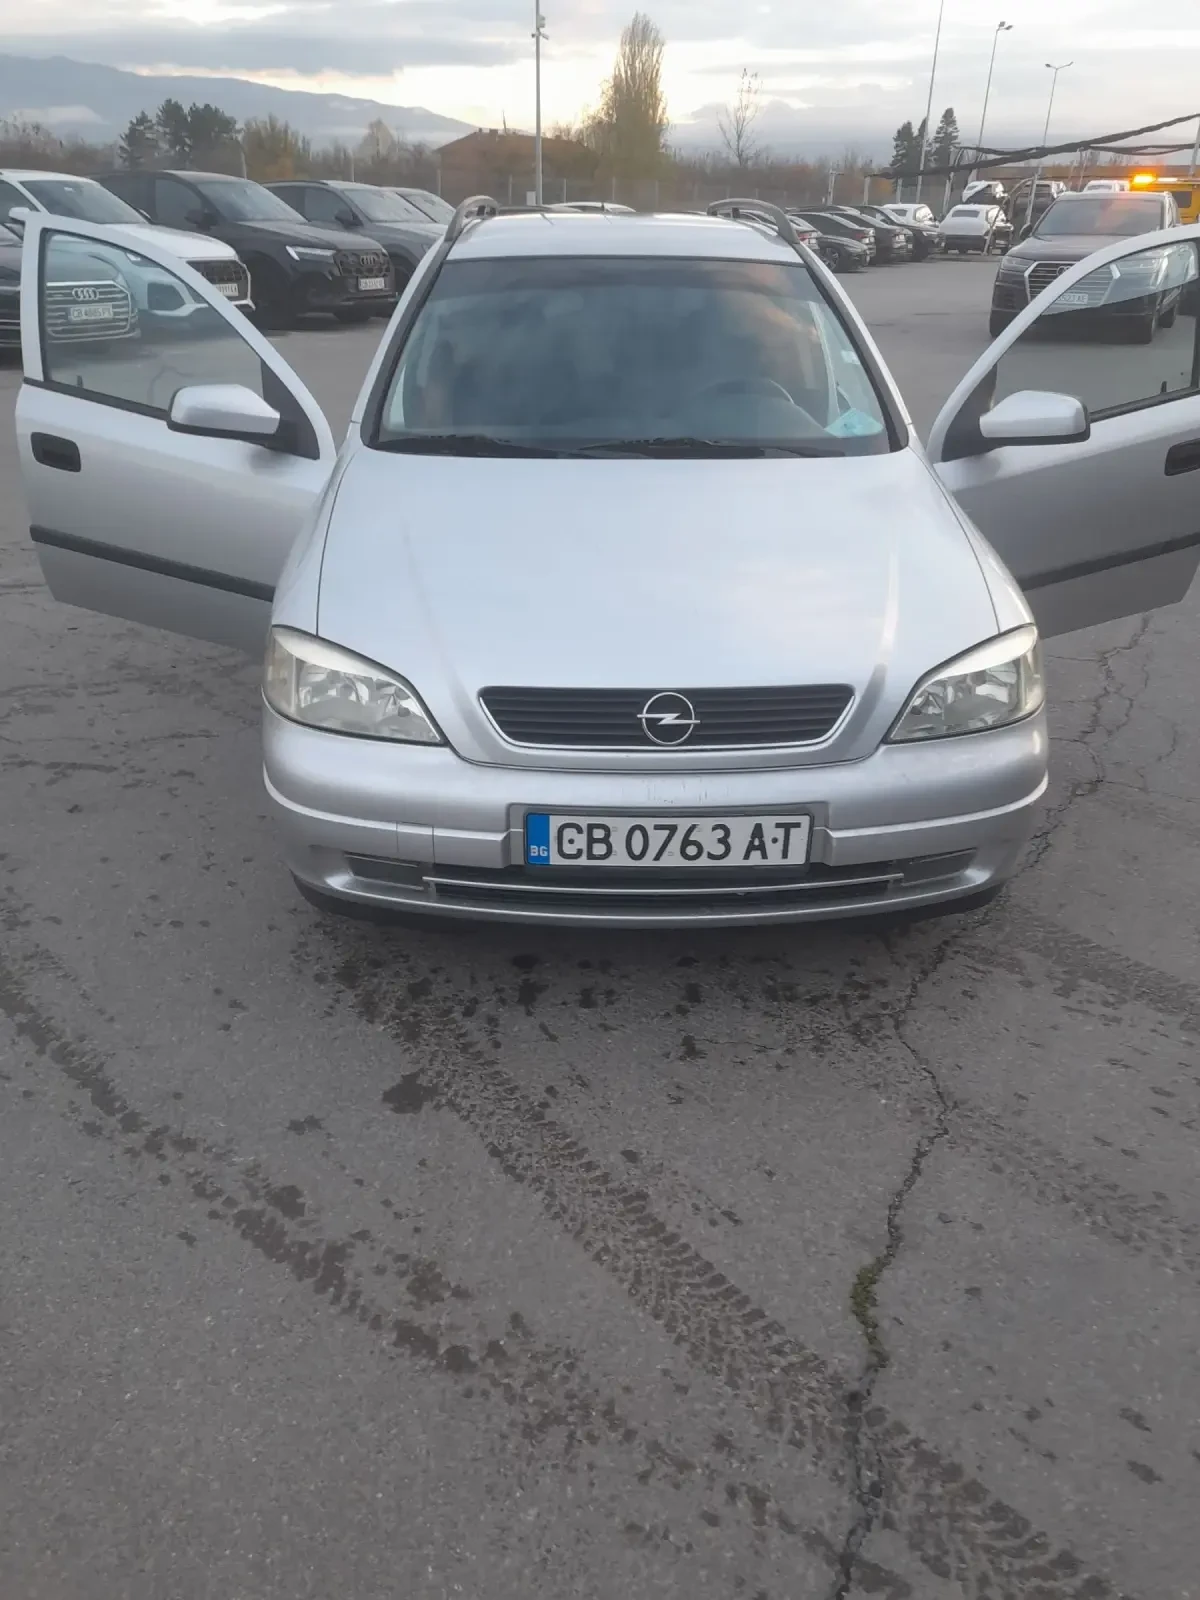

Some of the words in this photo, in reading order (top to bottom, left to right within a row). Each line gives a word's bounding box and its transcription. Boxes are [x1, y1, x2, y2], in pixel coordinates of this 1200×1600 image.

[530, 845, 548, 856] BG
[556, 822, 614, 861] CB
[625, 823, 731, 861] 0763
[742, 822, 802, 860] AT
